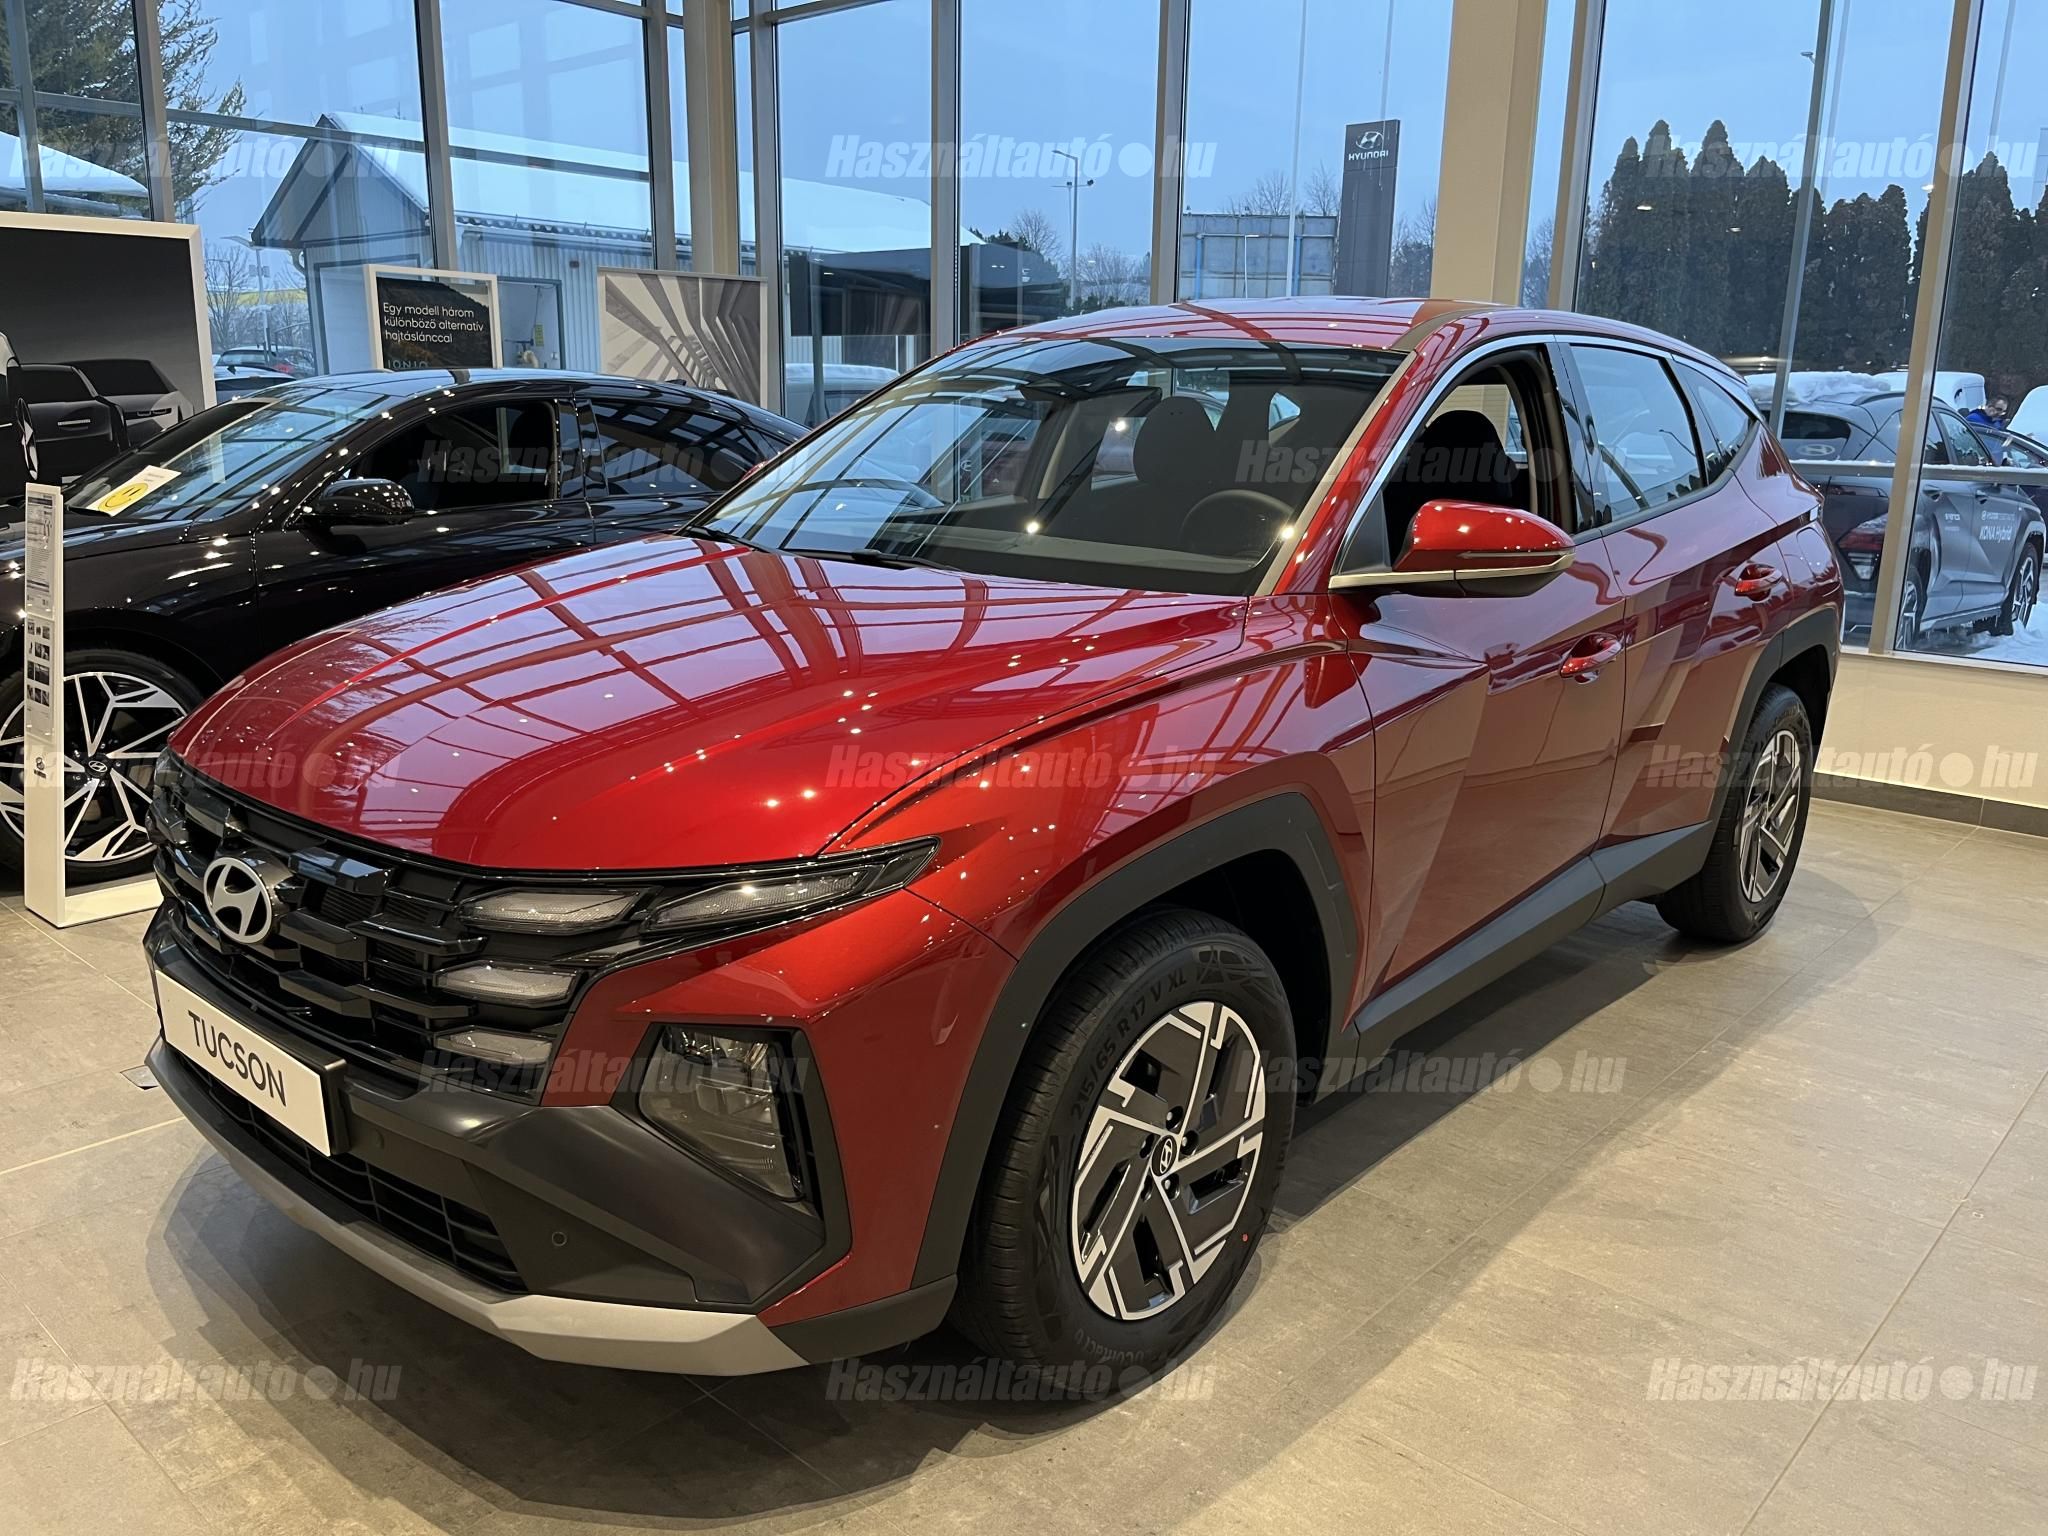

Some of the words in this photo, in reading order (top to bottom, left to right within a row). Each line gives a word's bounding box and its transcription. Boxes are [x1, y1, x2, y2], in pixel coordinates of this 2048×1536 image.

[1348, 150, 1389, 161] HYUNDAI
[383, 302, 402, 315] Egy
[404, 304, 440, 316] modell
[441, 306, 474, 318] három
[384, 316, 436, 329] különböző
[438, 320, 484, 332] alternatív
[385, 330, 453, 343] hajtáslánccal
[188, 1009, 287, 1107] TUCSON
